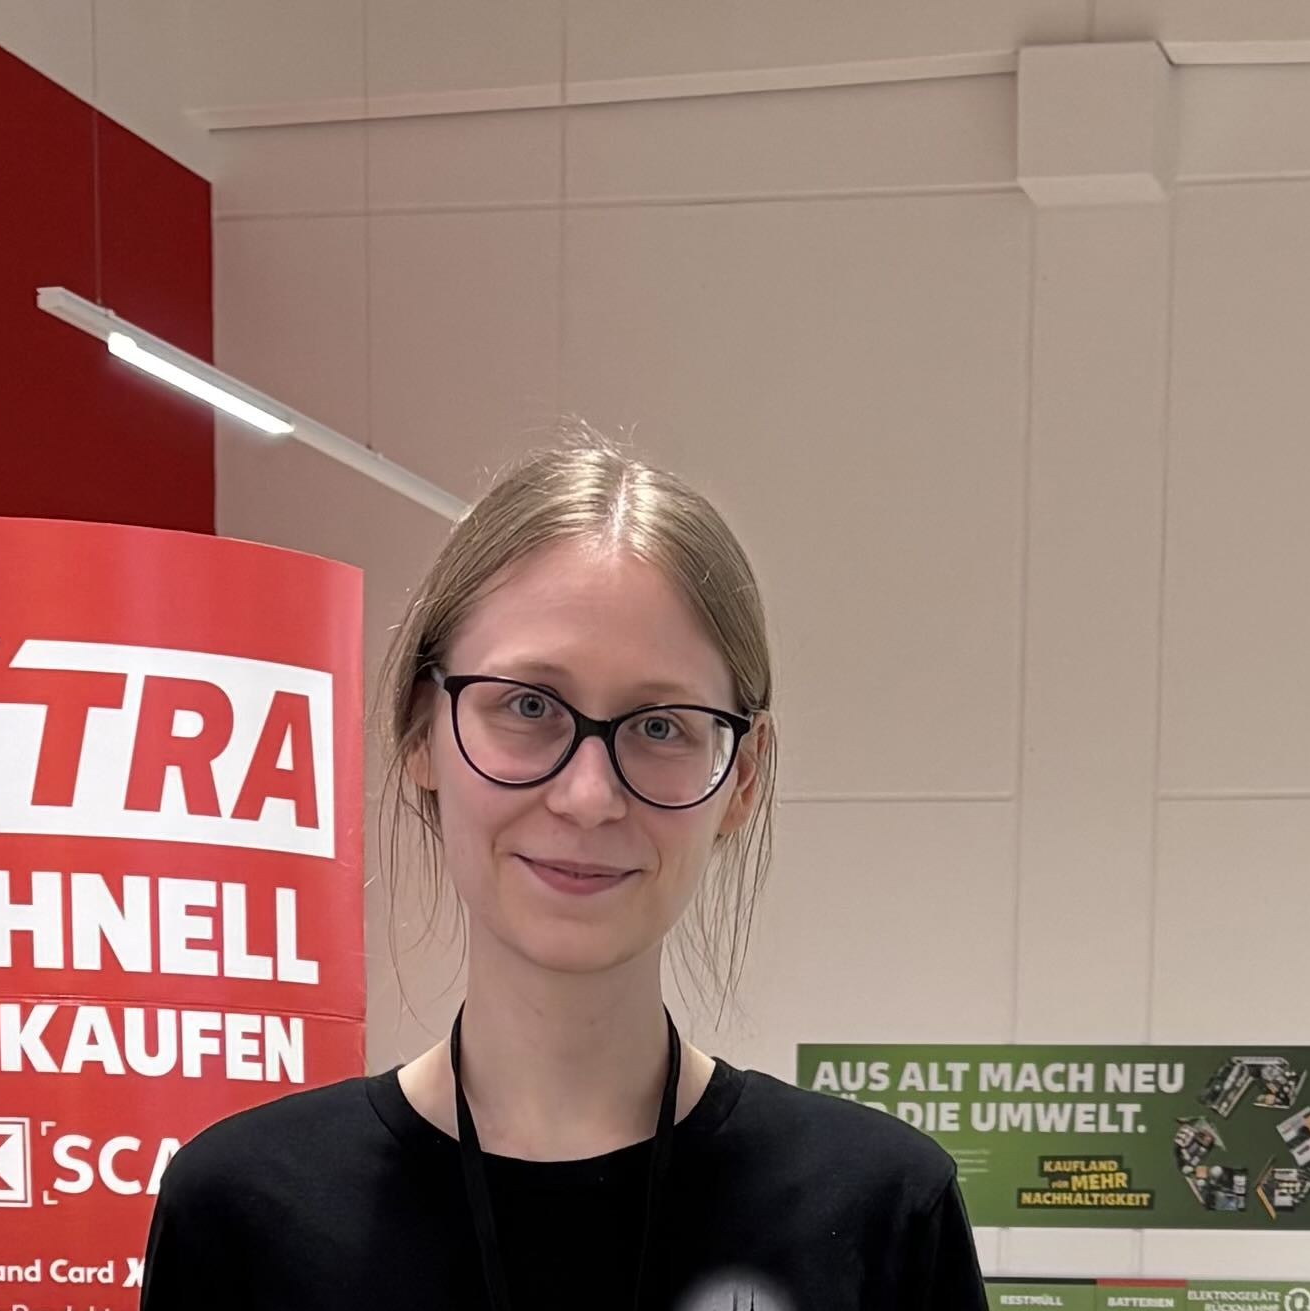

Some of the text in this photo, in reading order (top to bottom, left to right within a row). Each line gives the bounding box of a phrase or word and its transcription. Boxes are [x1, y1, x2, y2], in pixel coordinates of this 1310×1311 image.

[811, 1061, 1186, 1095] AUS ALT MACH NEU
[897, 1102, 961, 1132] DIE
[970, 1103, 1148, 1134] UMWELT.
[1043, 1160, 1119, 1173] KAUFLAND
[1071, 1172, 1128, 1191] MEHR
[1020, 1192, 1151, 1207] NACHHALTIGKEIT
[49, 1259, 114, 1284] Card
[1000, 1293, 1064, 1307] RESTMÜLL
[1107, 1296, 1175, 1309] BATTERIEN
[1187, 1289, 1280, 1303] ELEKTROGERÄTE
